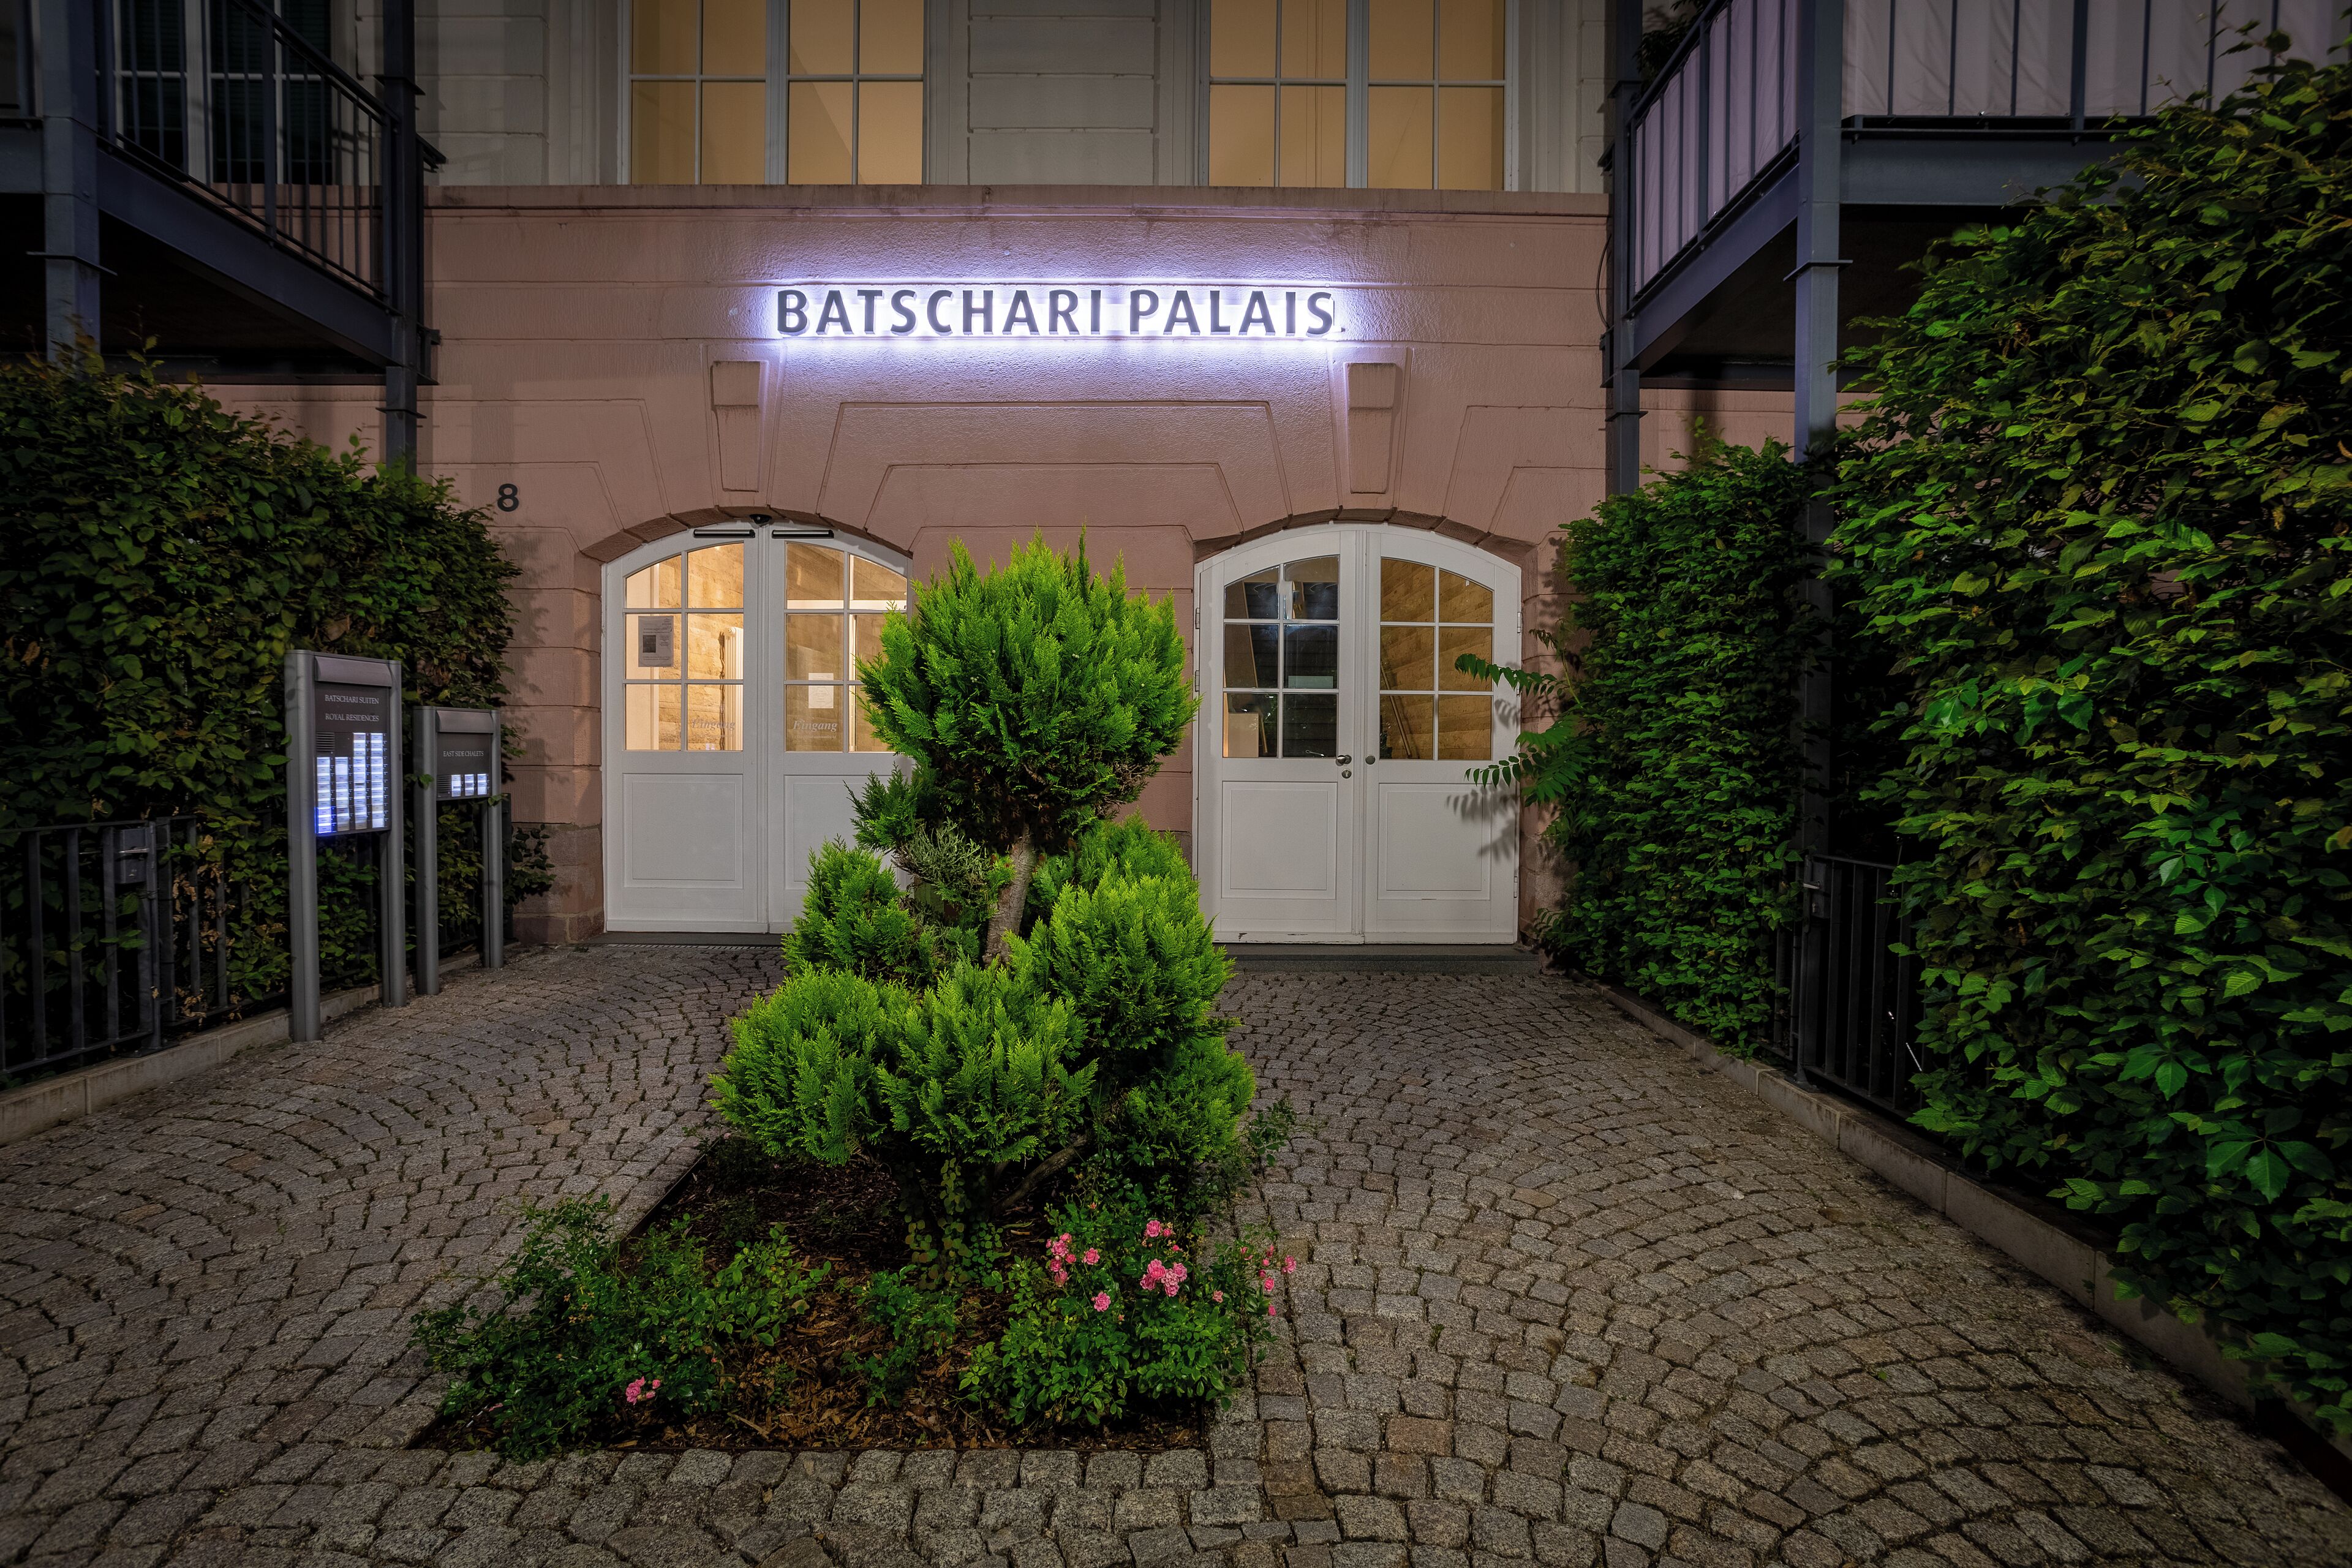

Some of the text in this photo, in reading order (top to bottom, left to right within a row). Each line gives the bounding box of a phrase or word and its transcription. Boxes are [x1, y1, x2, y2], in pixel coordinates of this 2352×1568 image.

[777, 289, 1333, 337] BATSCHARI PALAIS
[497, 483, 519, 512] 8
[325, 695, 358, 703] BATSCHARI
[793, 720, 838, 732] Eingang
